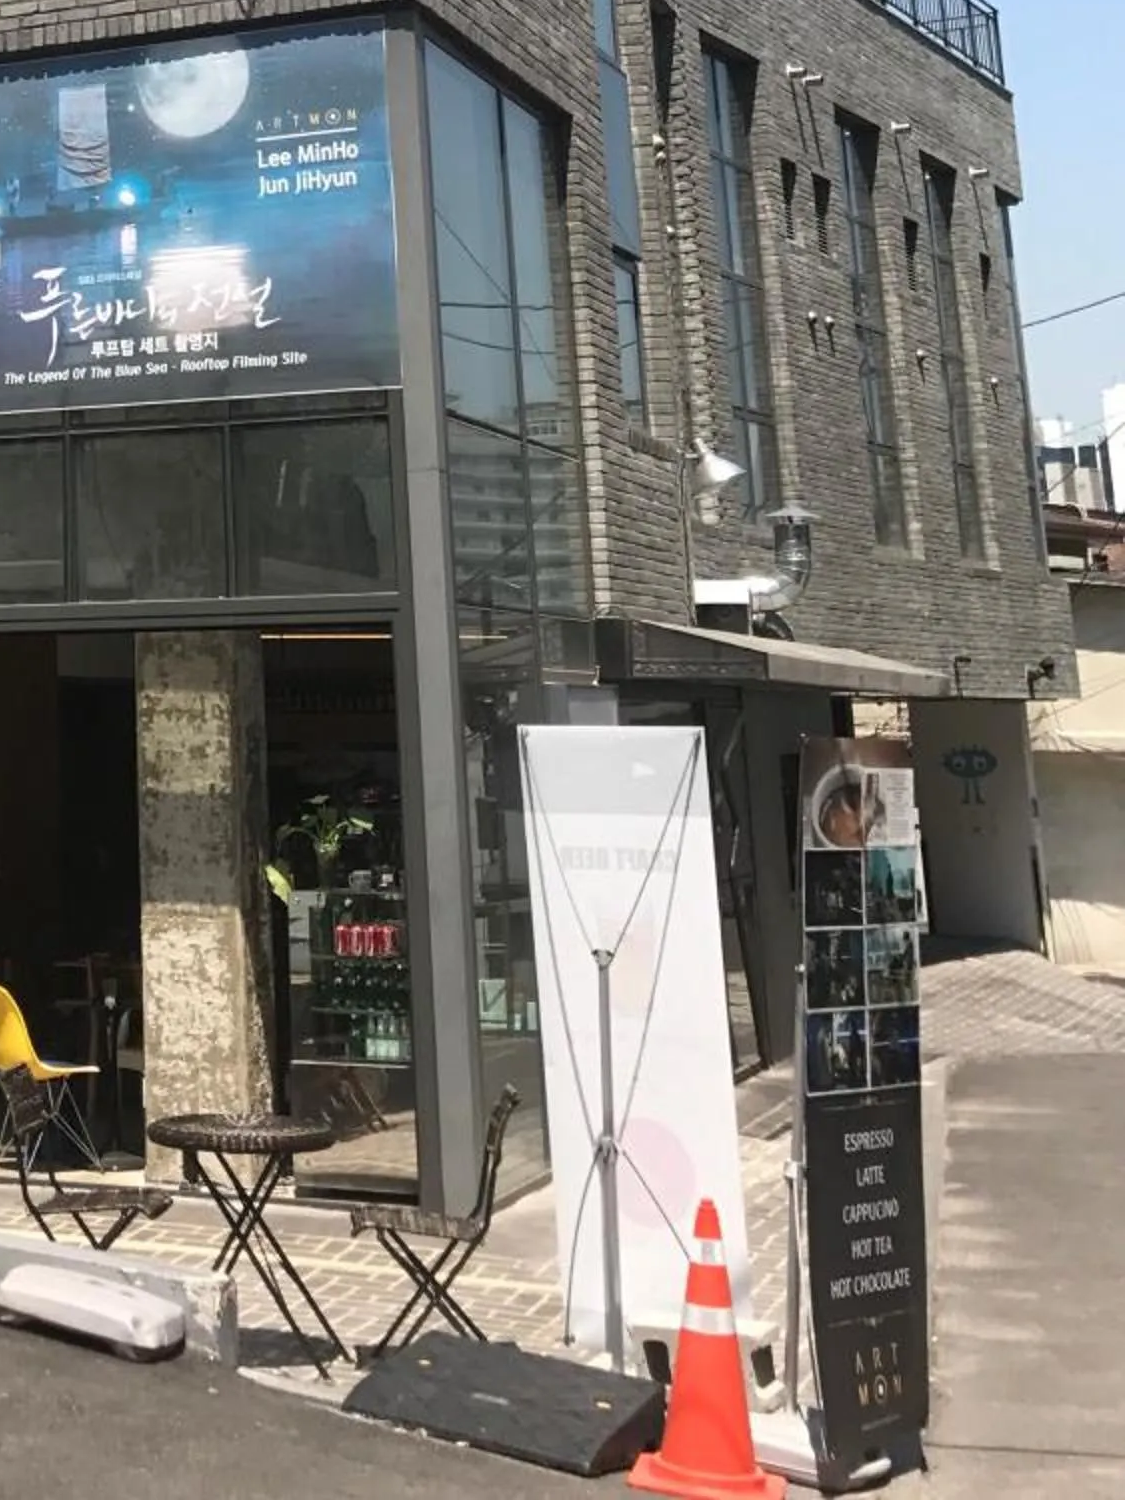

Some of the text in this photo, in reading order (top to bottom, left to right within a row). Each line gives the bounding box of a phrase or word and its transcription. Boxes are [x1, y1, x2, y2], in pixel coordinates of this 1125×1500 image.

[257, 140, 359, 169] Lee MinHo
[257, 169, 358, 199] Jun JiHyun
[90, 339, 134, 359] 루프탑
[139, 335, 169, 355] 세트
[4, 371, 25, 385] The
[28, 369, 69, 385] Legend
[73, 367, 86, 381] Of
[91, 366, 111, 380] The
[115, 363, 142, 377] Blue
[146, 362, 168, 375] Sea
[180, 358, 229, 374] Rooftop
[232, 354, 278, 370] Filming
[282, 350, 308, 365] Site
[844, 1127, 895, 1153] ESPRESSO
[856, 1165, 886, 1188] LATTE
[851, 1236, 894, 1260] HOT TEA
[830, 1268, 912, 1300] HOT CHOCOLATE
[856, 1342, 899, 1375] ART
